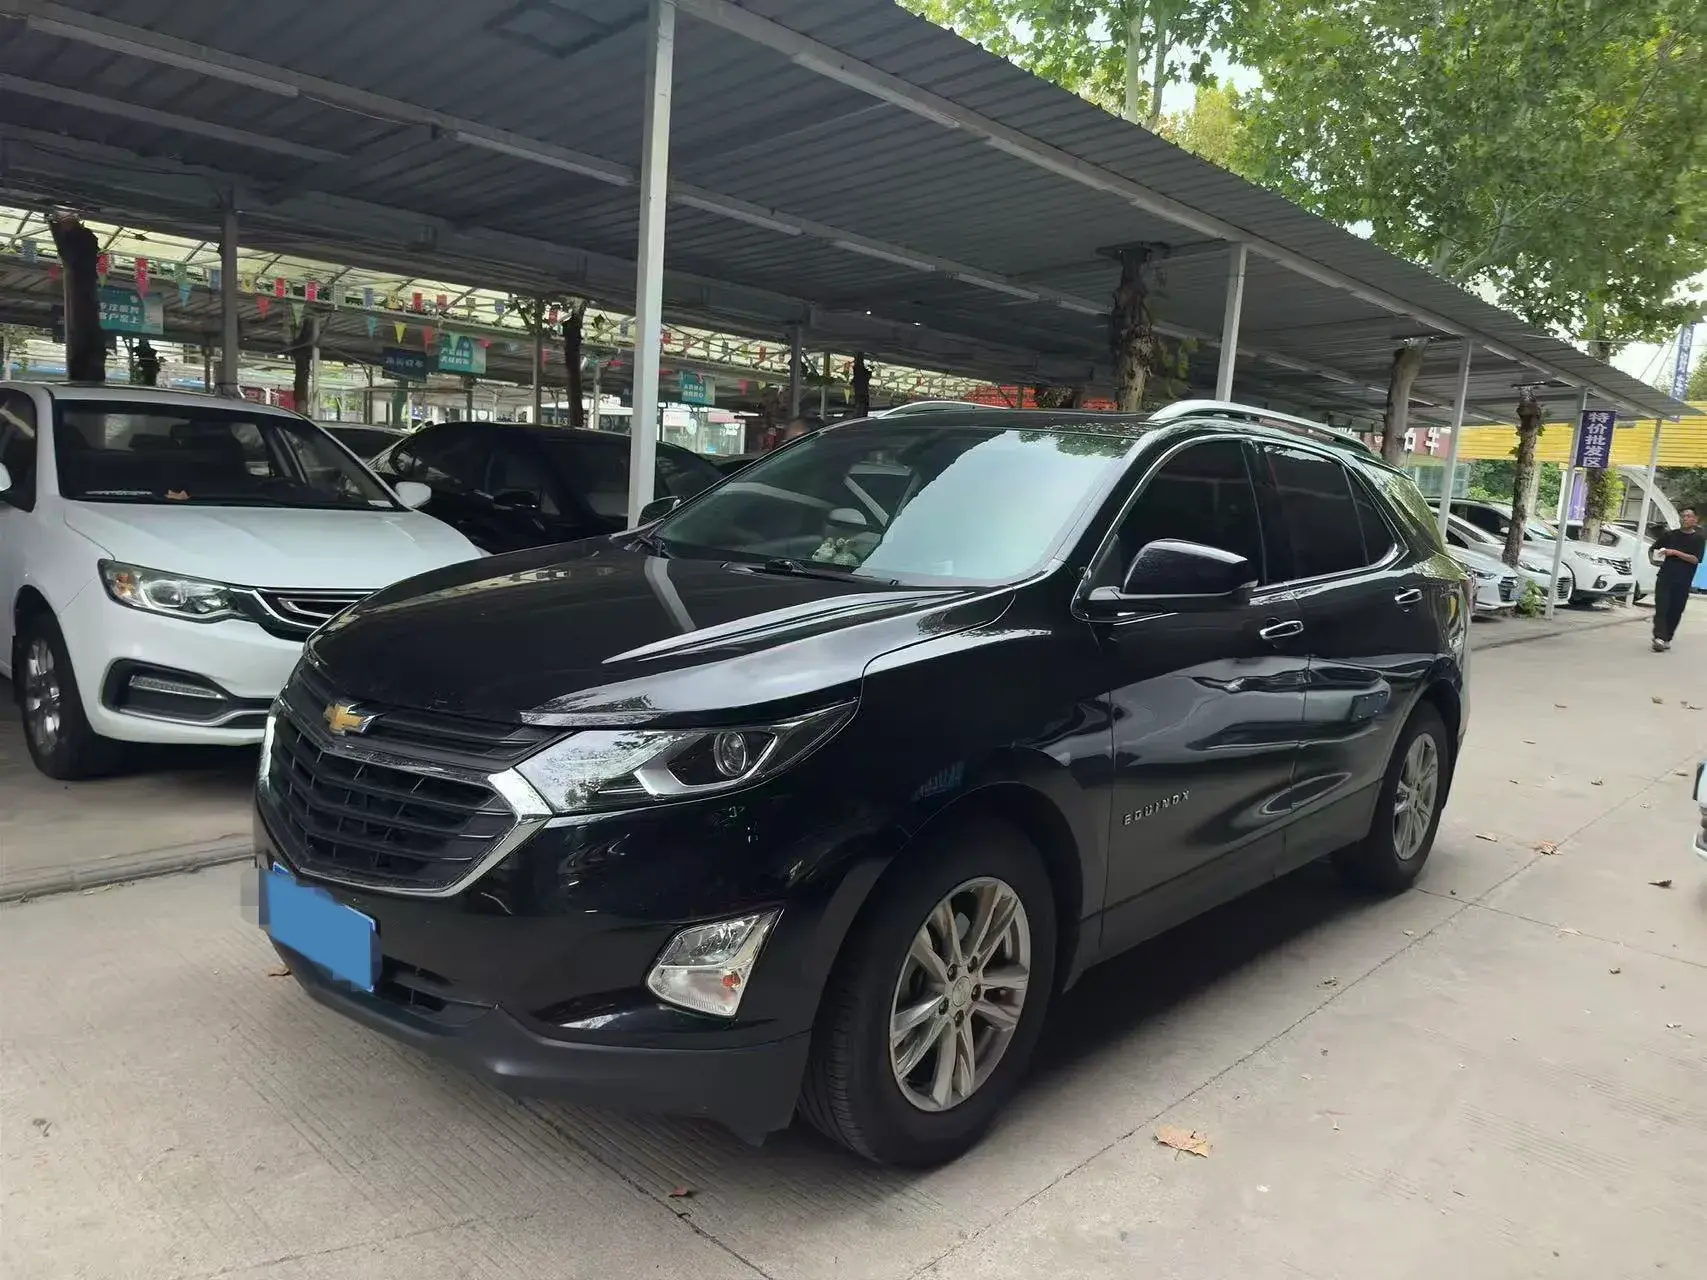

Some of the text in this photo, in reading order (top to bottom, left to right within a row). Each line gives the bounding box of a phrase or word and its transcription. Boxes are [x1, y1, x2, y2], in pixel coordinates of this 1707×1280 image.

[1583, 412, 1610, 467] 特价批发区
[1122, 790, 1189, 826] EQUINOX
